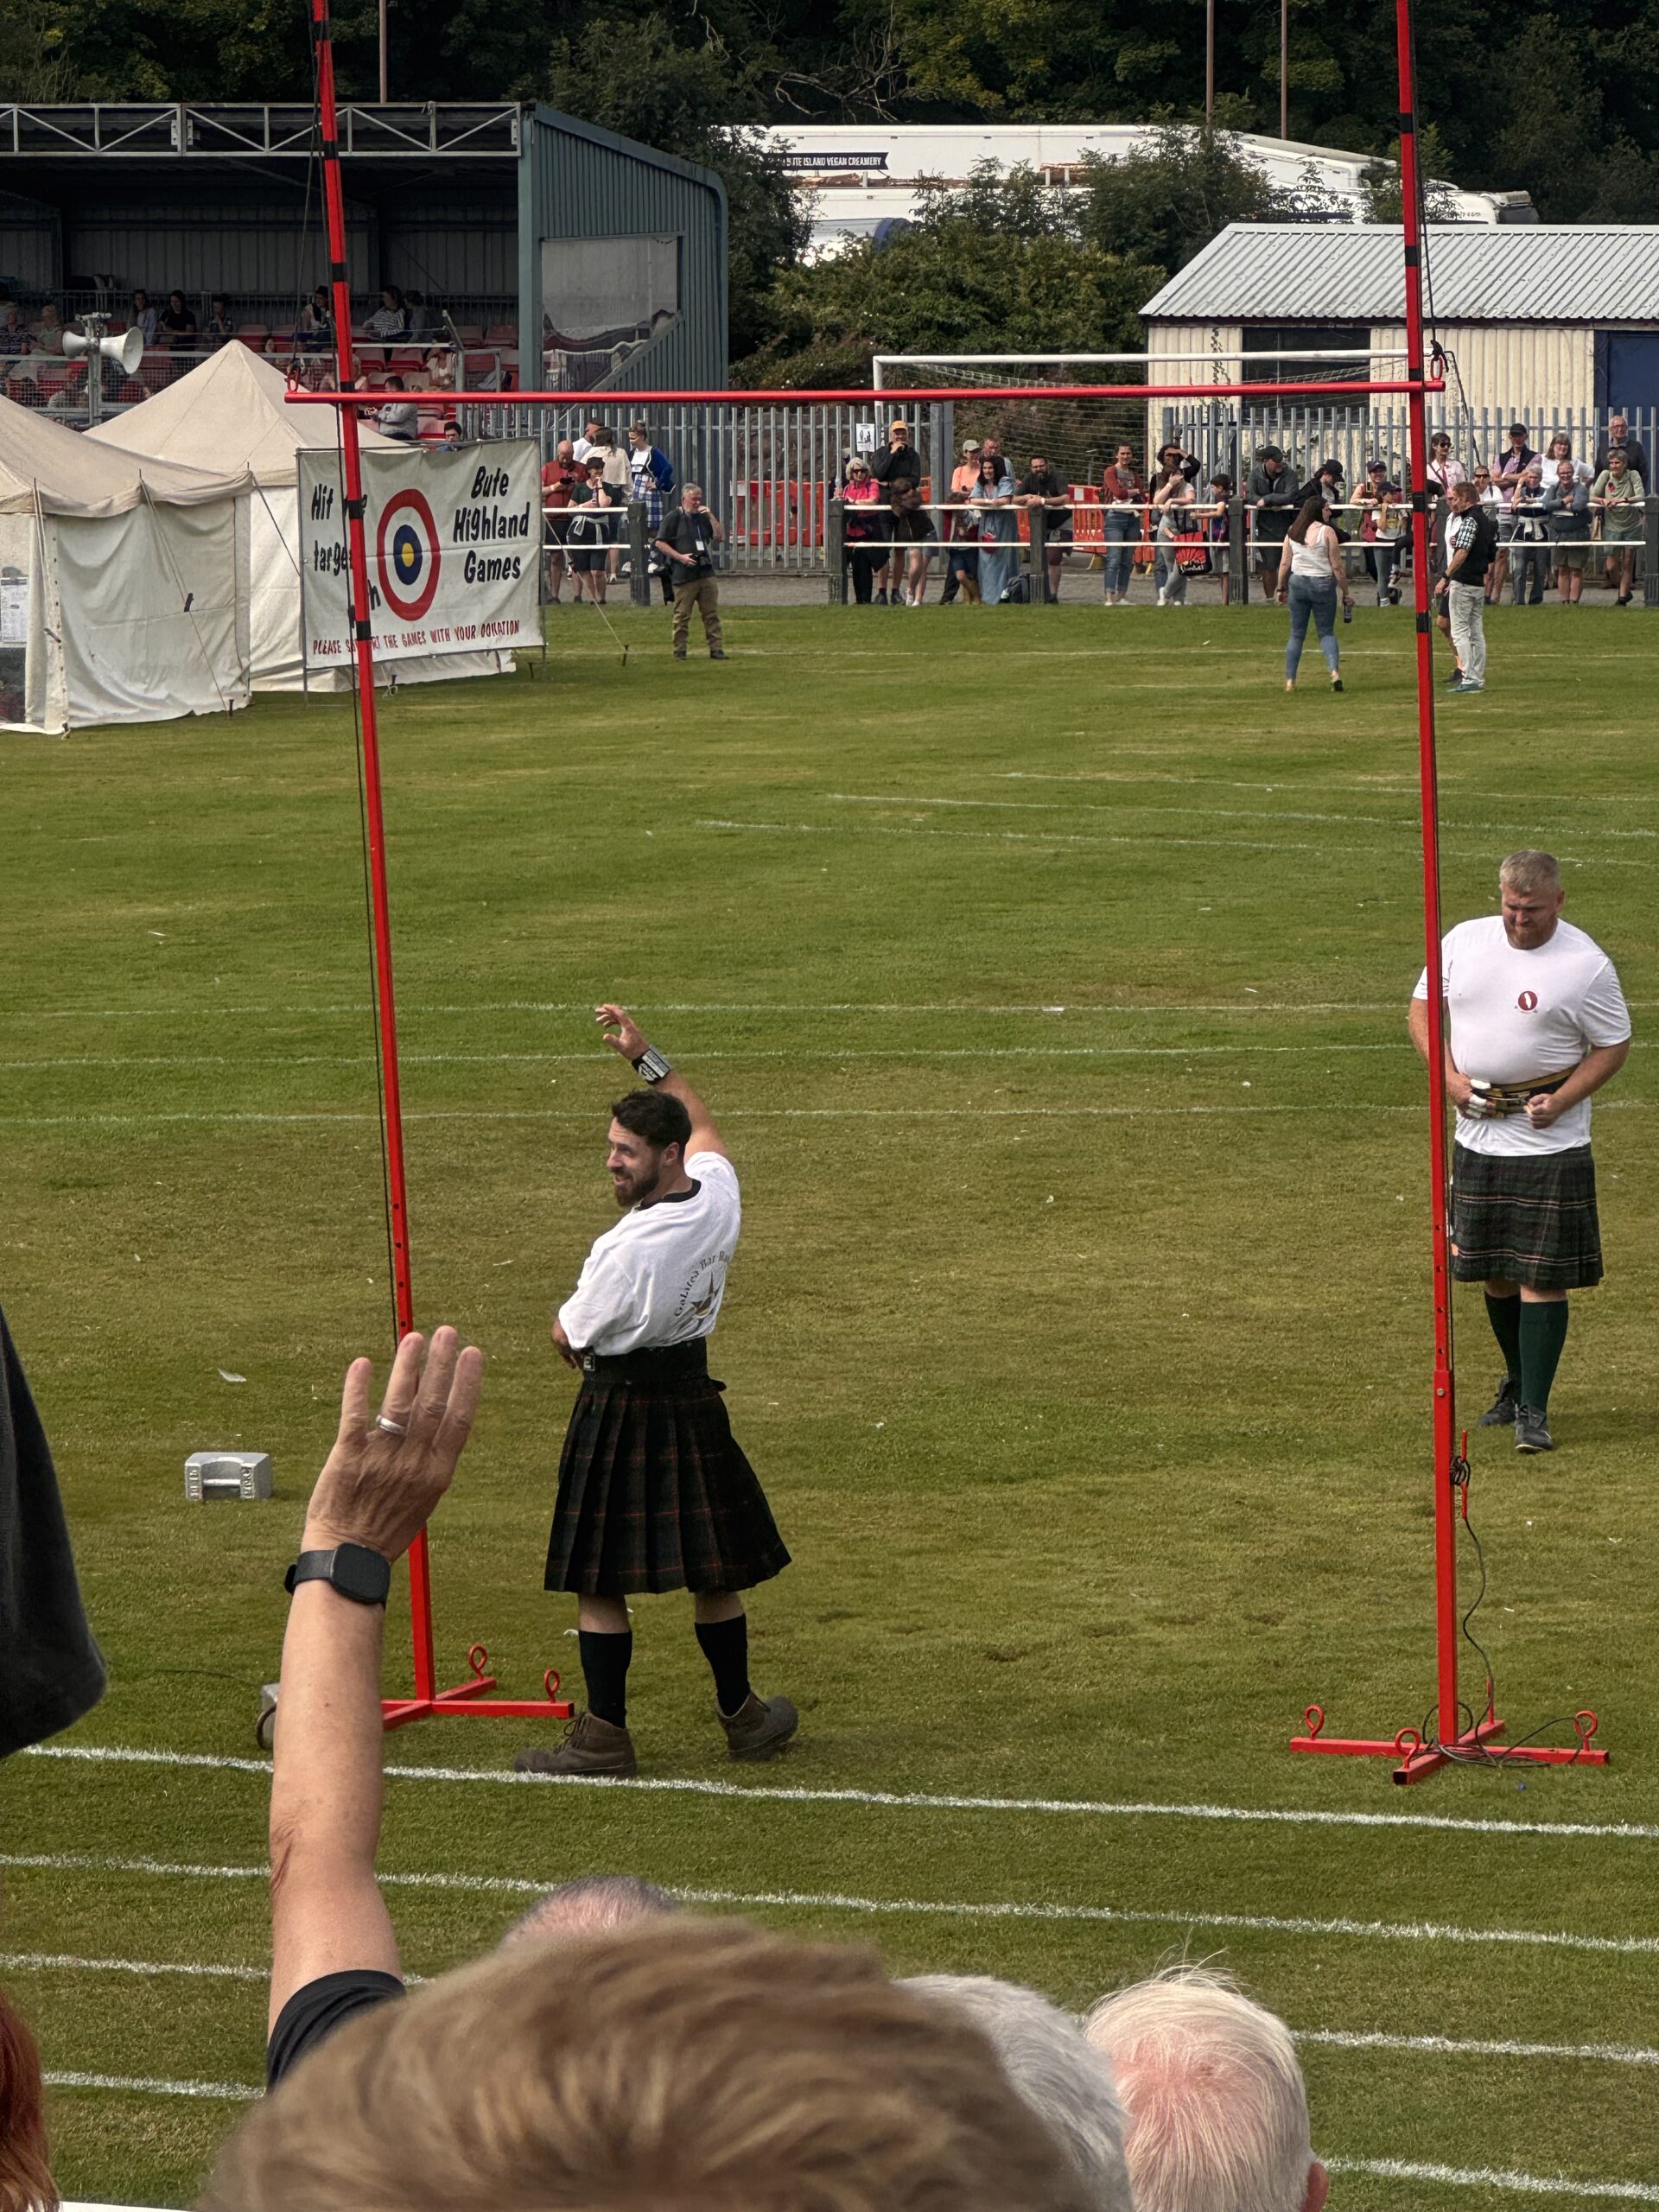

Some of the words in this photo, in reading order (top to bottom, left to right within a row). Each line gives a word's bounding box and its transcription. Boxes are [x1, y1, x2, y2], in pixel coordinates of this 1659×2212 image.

[786, 157, 802, 167] BTE
[803, 157, 826, 166] ISLAND
[827, 157, 847, 166] VEGAN
[849, 156, 881, 166] CREAMERY
[470, 466, 509, 499] Bute
[312, 483, 334, 520] Hit
[453, 502, 531, 543] Highland
[315, 540, 353, 576] targe
[464, 550, 520, 584] Games
[313, 639, 341, 655] PLEASE
[346, 636, 379, 653] SURT
[384, 634, 398, 649] THE
[402, 631, 426, 647] GAMES
[430, 627, 449, 644] WITH
[454, 625, 476, 641] YOUR
[481, 620, 519, 639] DONATION
